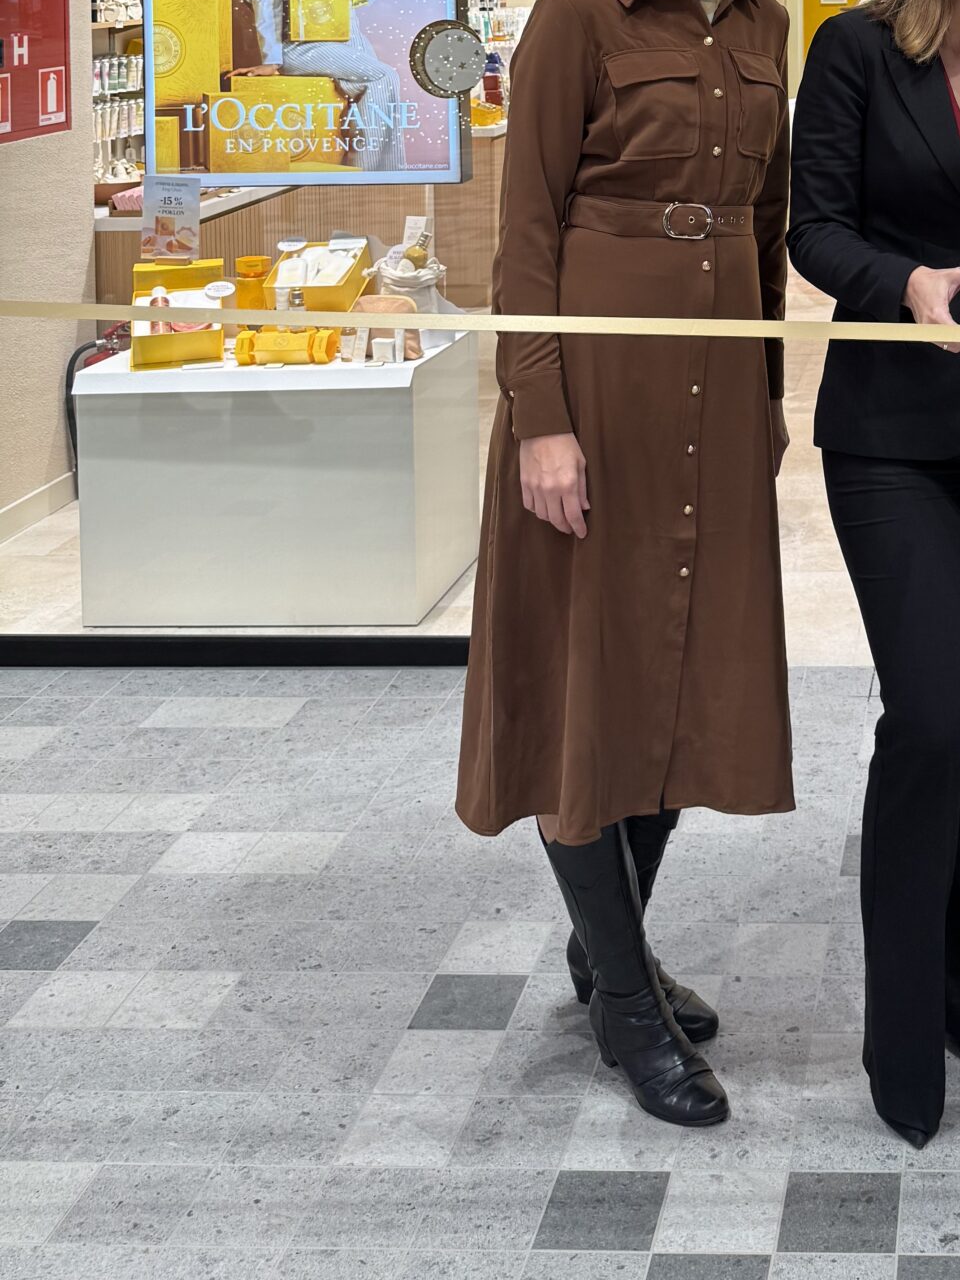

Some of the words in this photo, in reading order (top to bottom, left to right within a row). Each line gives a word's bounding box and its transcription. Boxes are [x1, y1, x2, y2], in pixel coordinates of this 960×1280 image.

[13, 35, 29, 67] H
[183, 97, 422, 132] L'OCCITANE
[225, 138, 253, 153] EN
[263, 136, 380, 153] PROVENCE
